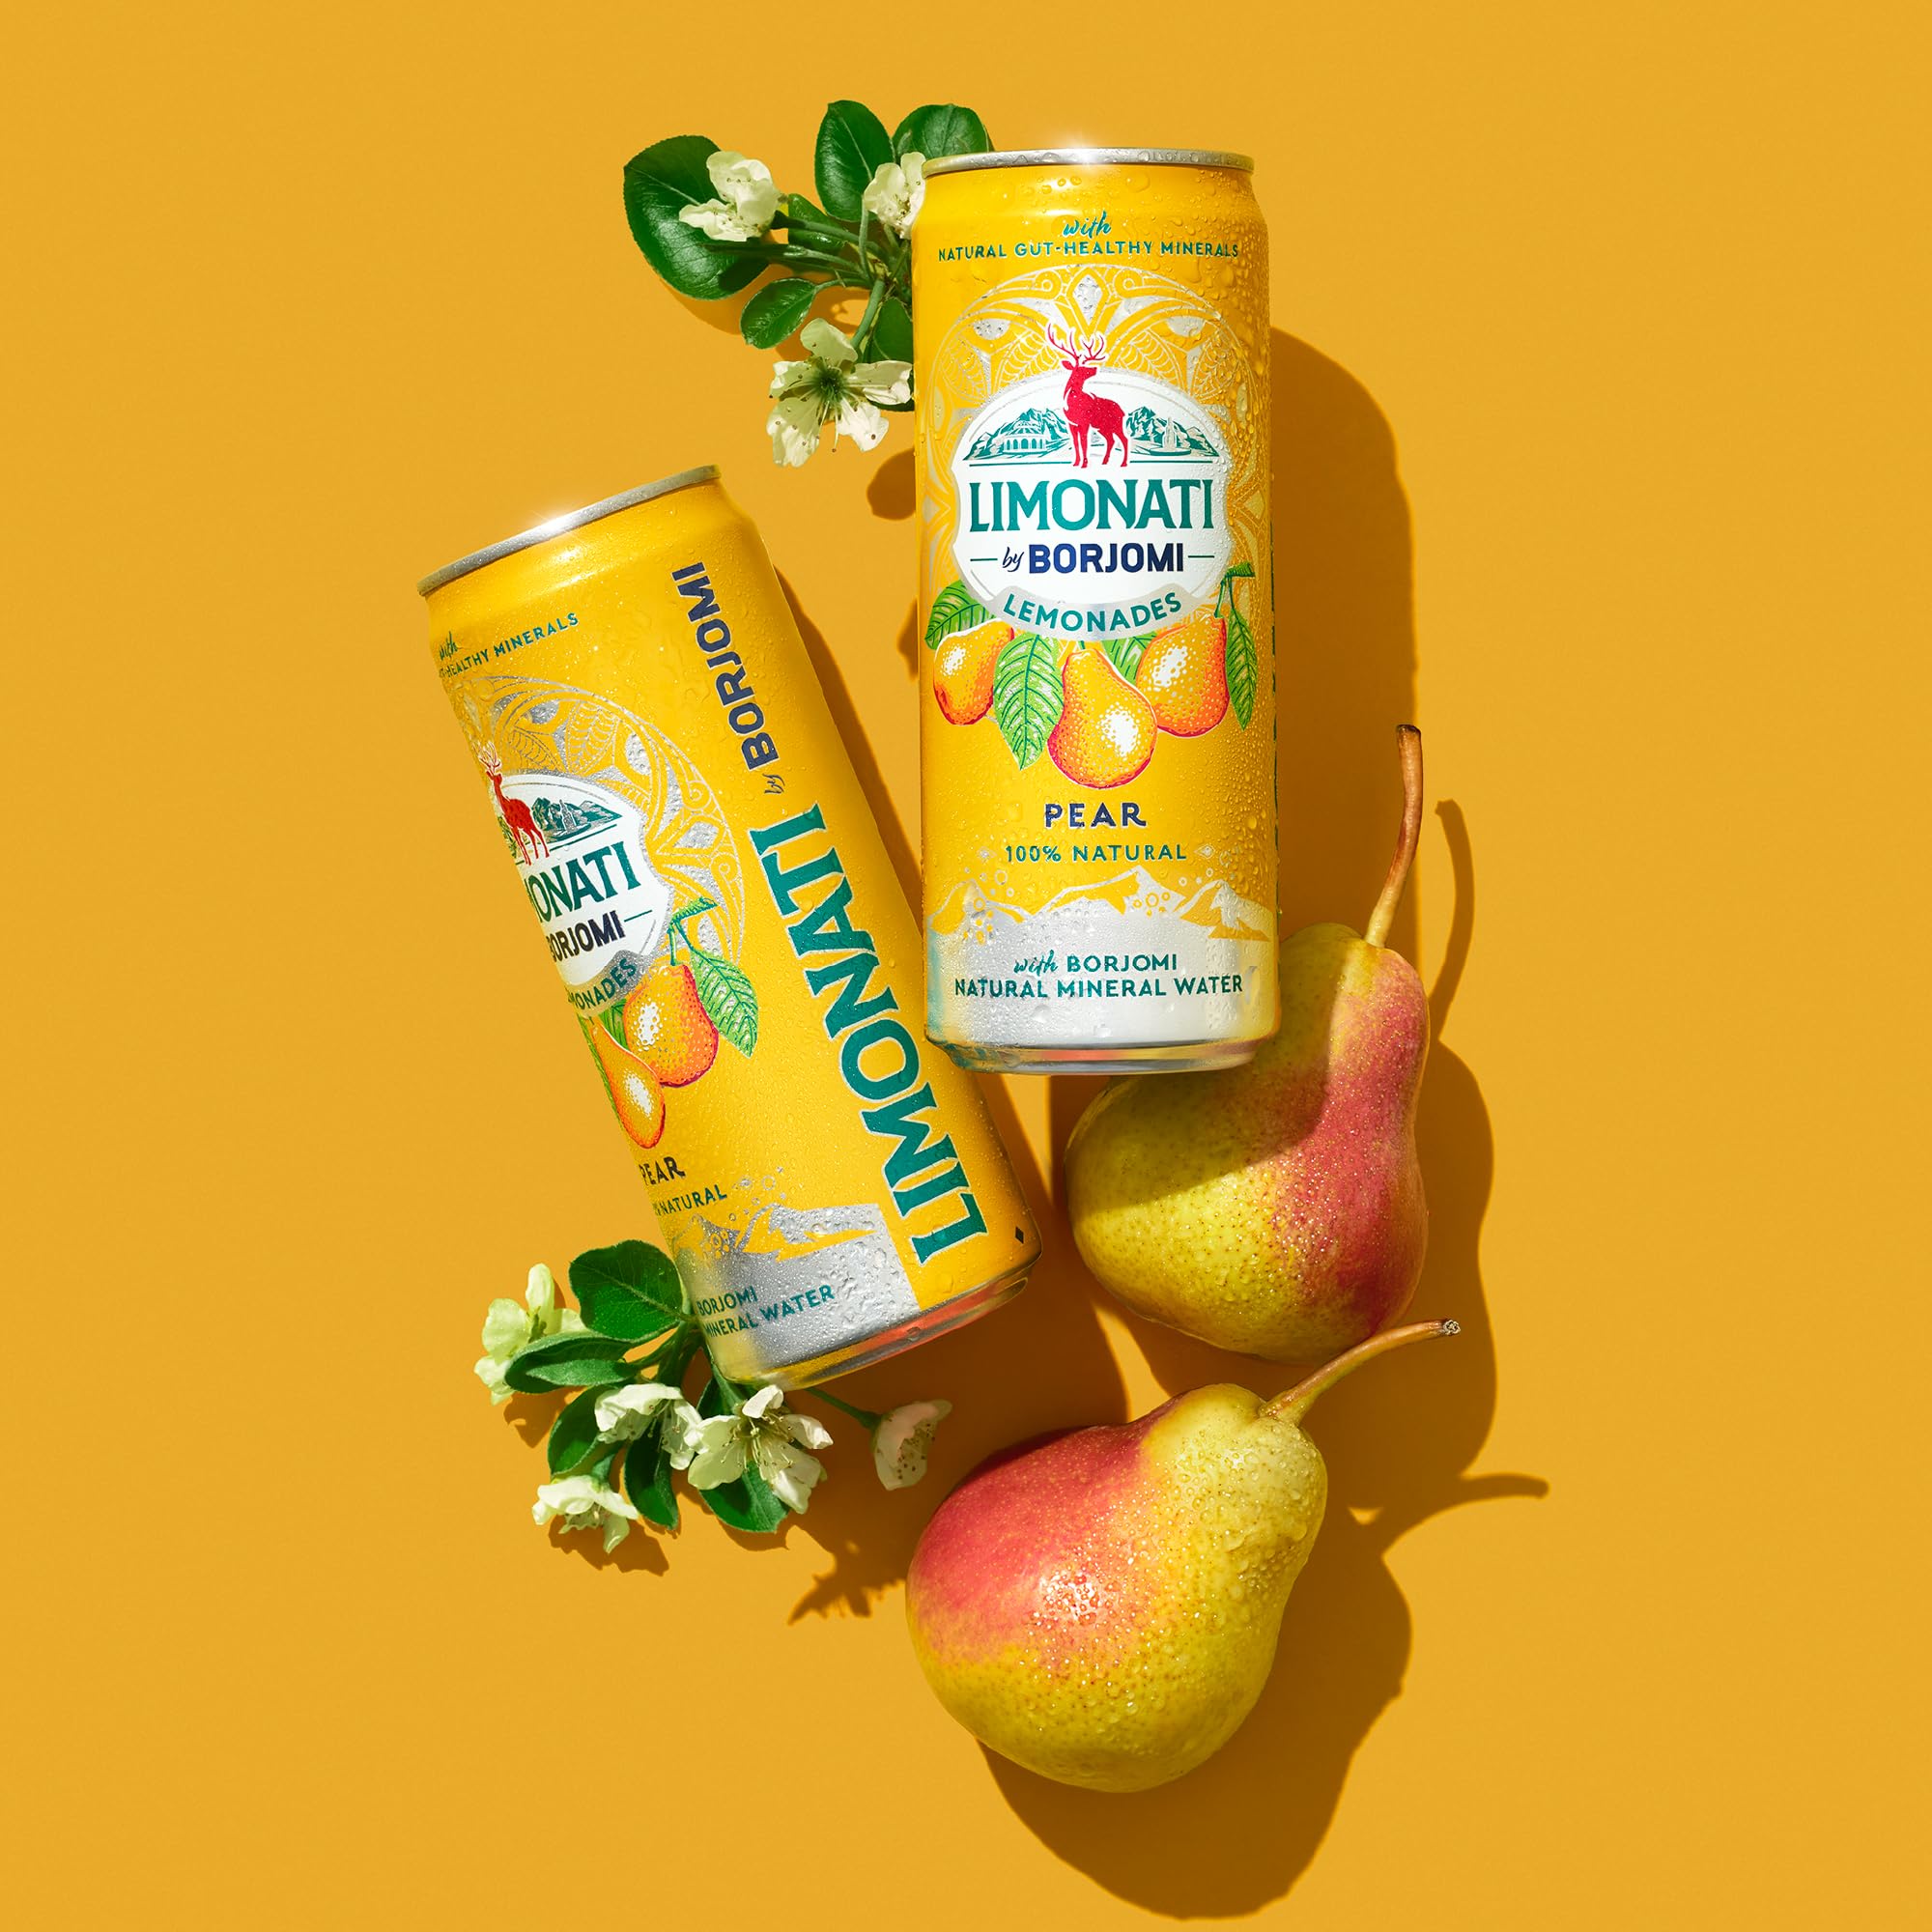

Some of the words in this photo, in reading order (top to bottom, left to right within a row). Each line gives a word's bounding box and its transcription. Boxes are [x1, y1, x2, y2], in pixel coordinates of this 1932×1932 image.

[1062, 210, 1112, 238] with
[938, 242, 1008, 262] NATURAL
[1014, 240, 1153, 258] GUT-HEALTHY
[1160, 241, 1239, 258] MINERALS
[969, 478, 1215, 532] LIMONATI
[1002, 546, 1024, 573] by
[1028, 542, 1184, 574] BORJOMI
[1003, 591, 1182, 633] LEMONADES
[494, 611, 580, 657] MINERALS
[670, 561, 781, 771] BORJOMI
[762, 773, 785, 794] by
[1044, 802, 1148, 828] PEAR
[1005, 844, 1062, 863] 100%
[1072, 843, 1187, 862] NATURAL
[525, 840, 641, 923] ONATI
[1013, 950, 1060, 978] with
[1066, 953, 1178, 973] BORJOMI
[954, 978, 1048, 999] NATURAL
[1057, 978, 1167, 998] MINERAL
[1174, 975, 1243, 996] WATER
[749, 801, 989, 1266] LIMONATI
[659, 1184, 727, 1215] NATURAL
[696, 1285, 758, 1317] BORJOMI
[759, 1284, 836, 1321] WATER
